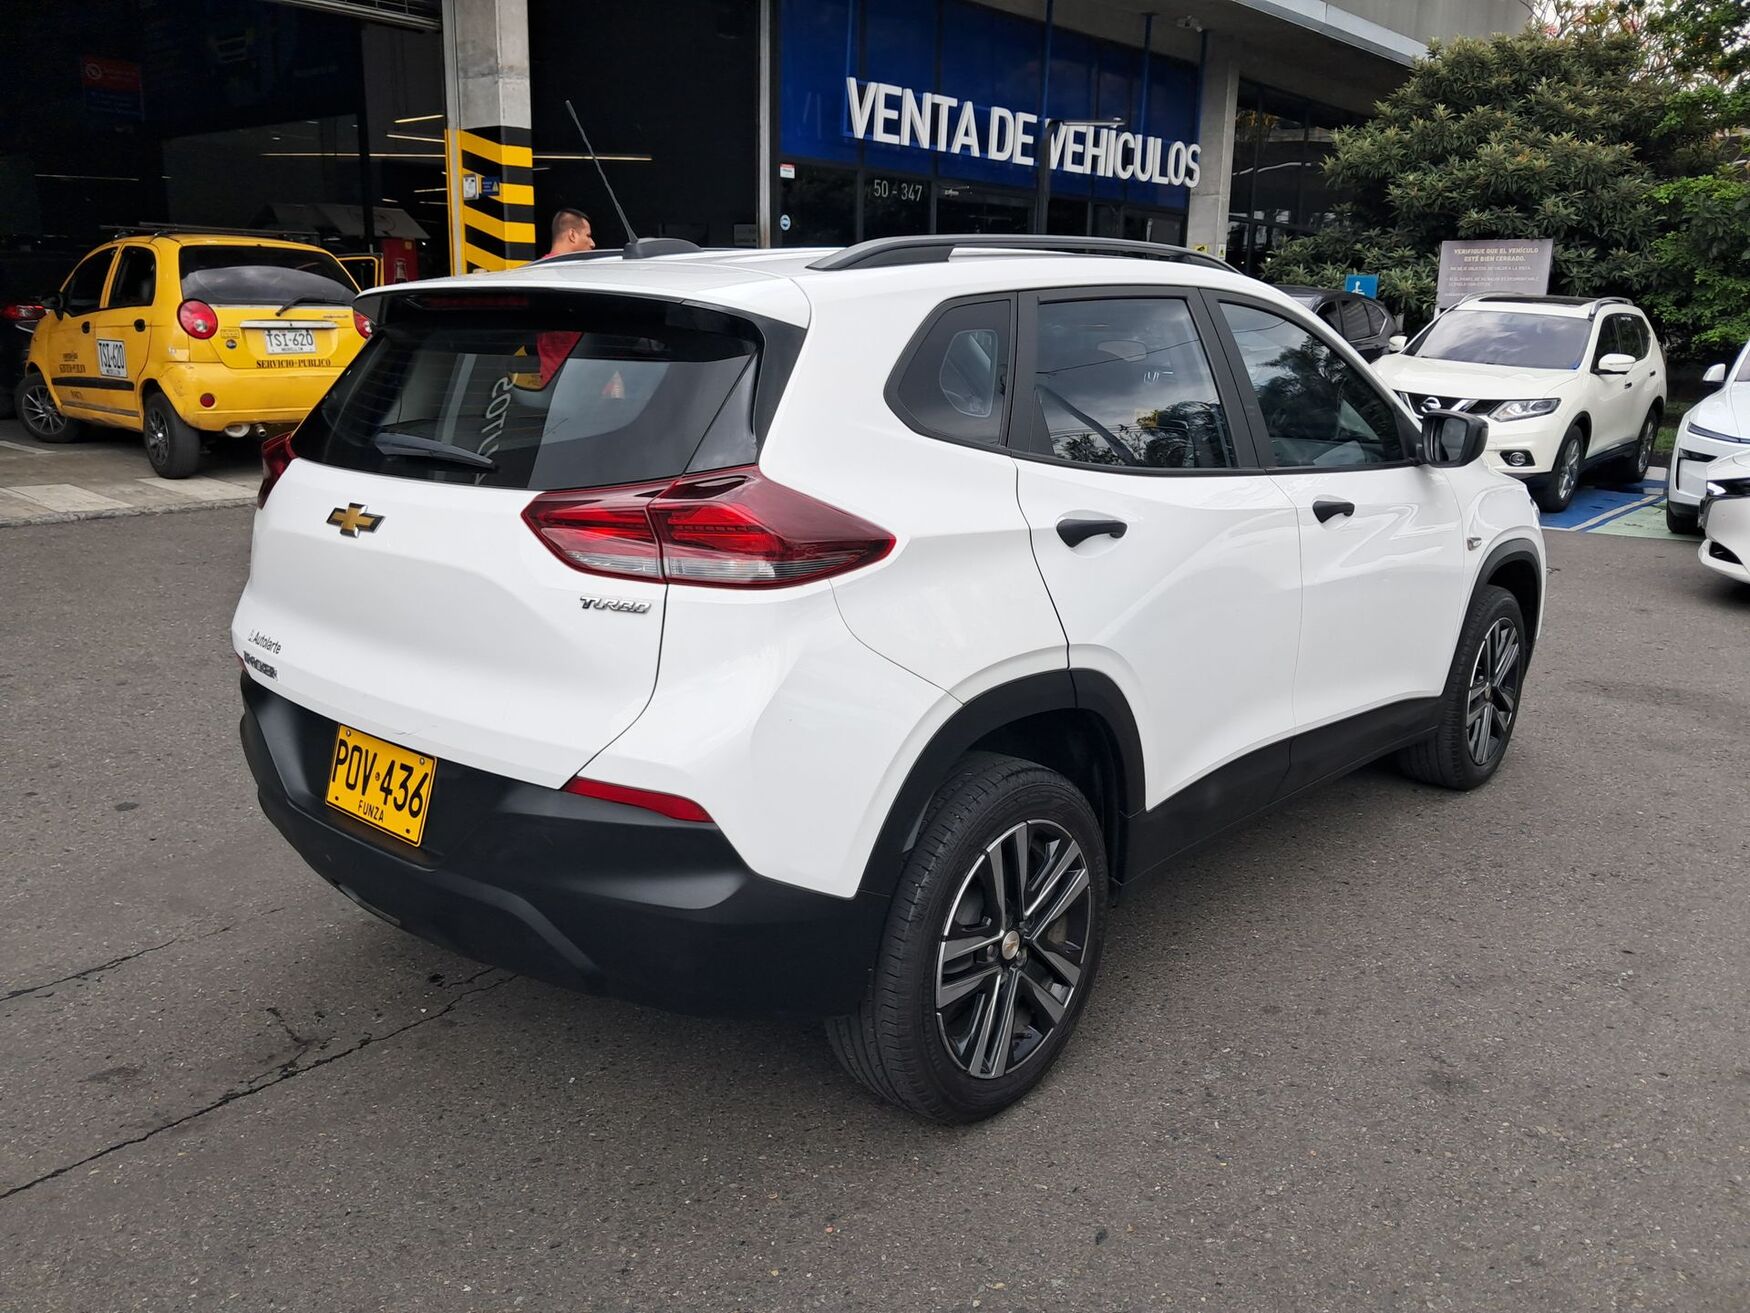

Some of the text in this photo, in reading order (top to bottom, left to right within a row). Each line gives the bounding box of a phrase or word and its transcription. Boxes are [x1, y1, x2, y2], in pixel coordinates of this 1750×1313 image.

[846, 76, 980, 157] VENTA
[987, 106, 1038, 166] DE
[873, 179, 889, 198] 50
[901, 183, 923, 202] 347
[256, 358, 331, 369] SERVICIO PUBLICO
[579, 596, 652, 614] TURBO
[357, 799, 384, 823] FUNZA
